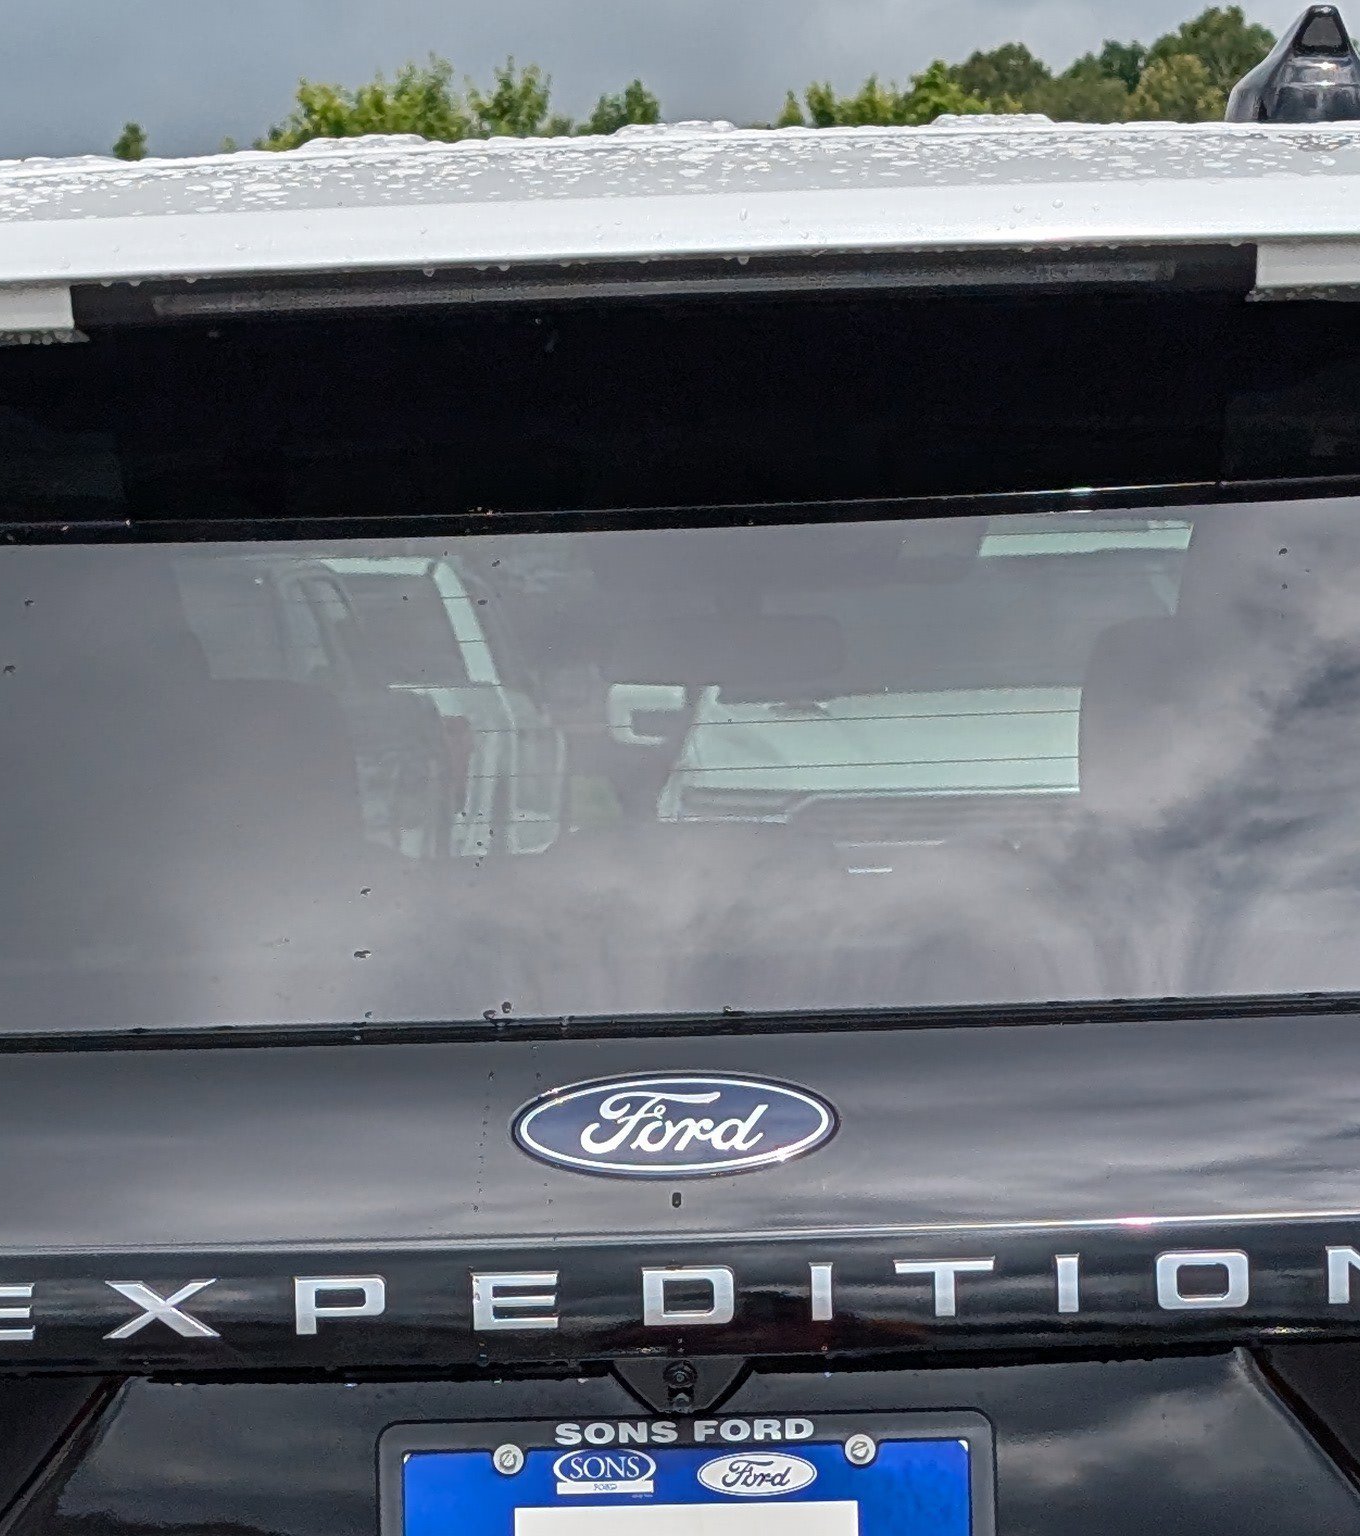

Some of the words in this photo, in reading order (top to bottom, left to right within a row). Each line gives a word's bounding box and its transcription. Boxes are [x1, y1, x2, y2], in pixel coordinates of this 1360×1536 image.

[580, 1091, 768, 1154] Ford
[555, 1421, 678, 1446] SONS
[693, 1418, 815, 1442] FORD
[570, 1456, 640, 1479] SONS
[721, 1459, 792, 1488] Ford
